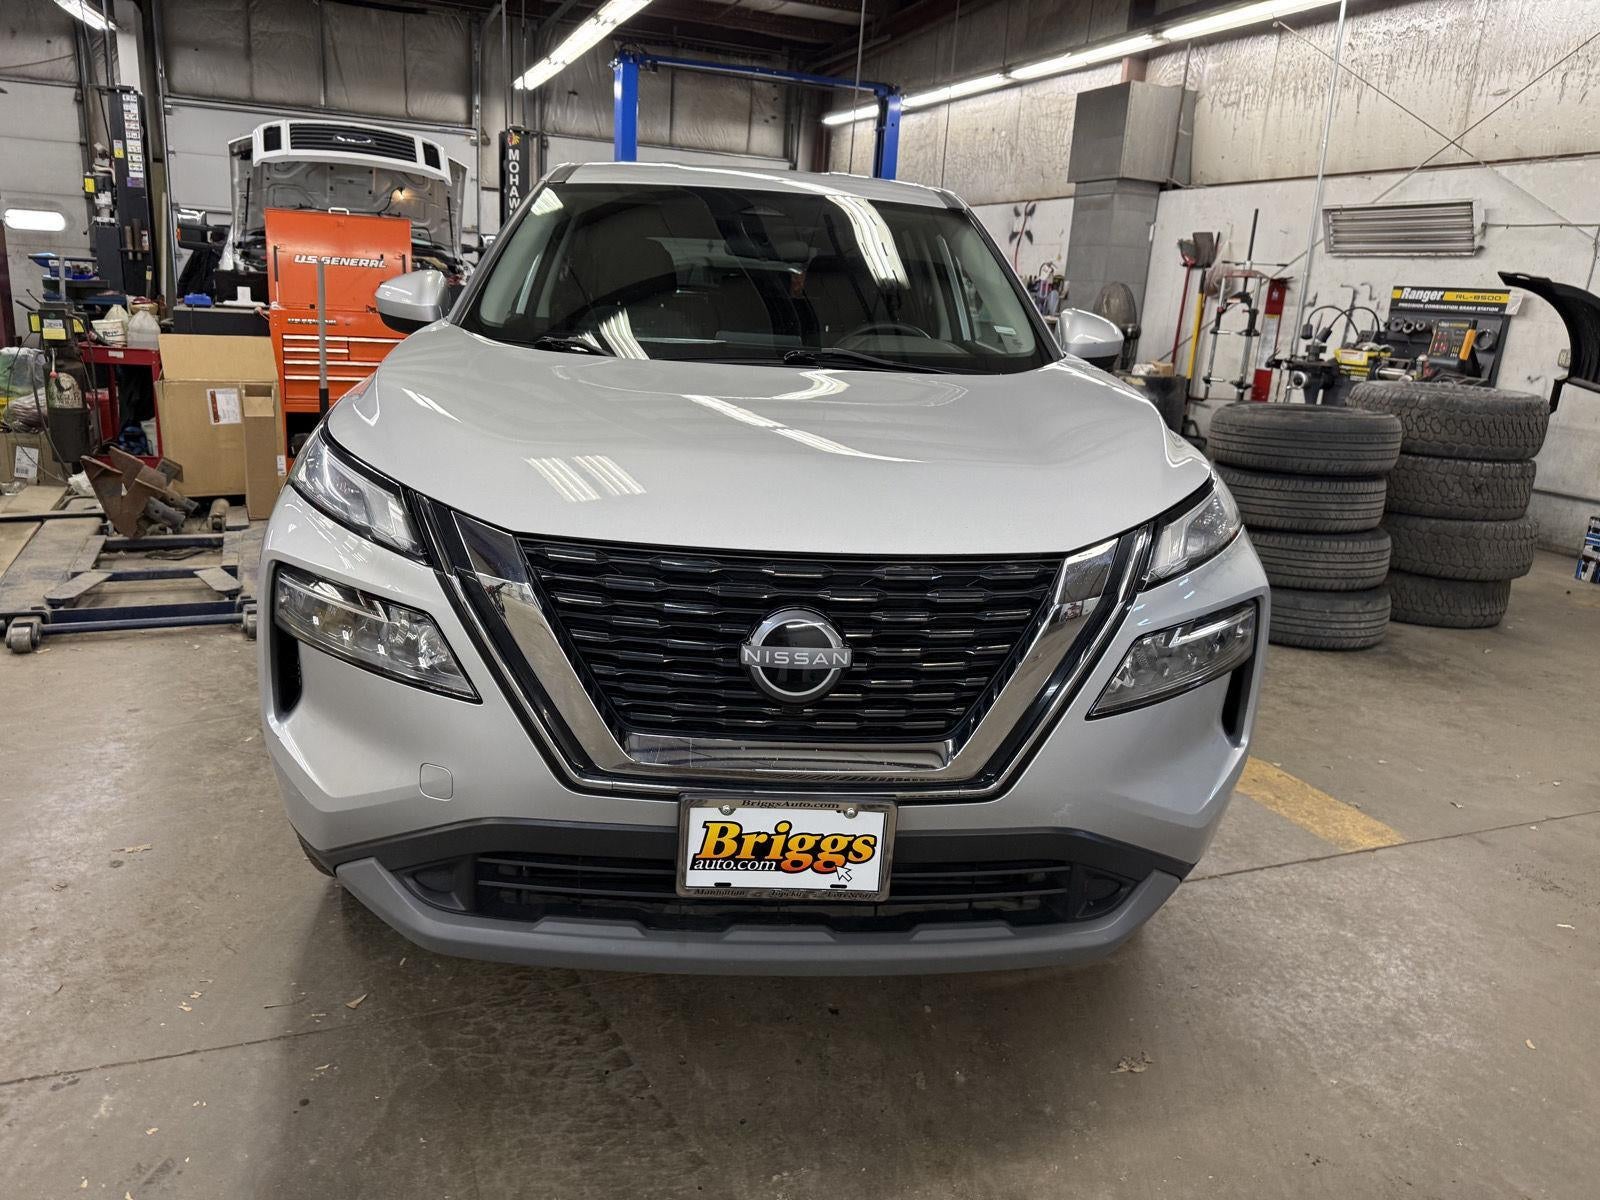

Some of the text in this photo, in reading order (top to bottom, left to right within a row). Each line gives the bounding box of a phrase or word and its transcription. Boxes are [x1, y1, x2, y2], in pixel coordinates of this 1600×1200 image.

[508, 148, 520, 216] MOHAW
[321, 256, 387, 268] GENERAL
[1401, 287, 1502, 302] Ranger RL-8500
[742, 646, 848, 665] NISSAN
[742, 800, 840, 809] BriggsAuto.com
[693, 820, 877, 874] Briggs
[694, 859, 776, 871] auto.com
